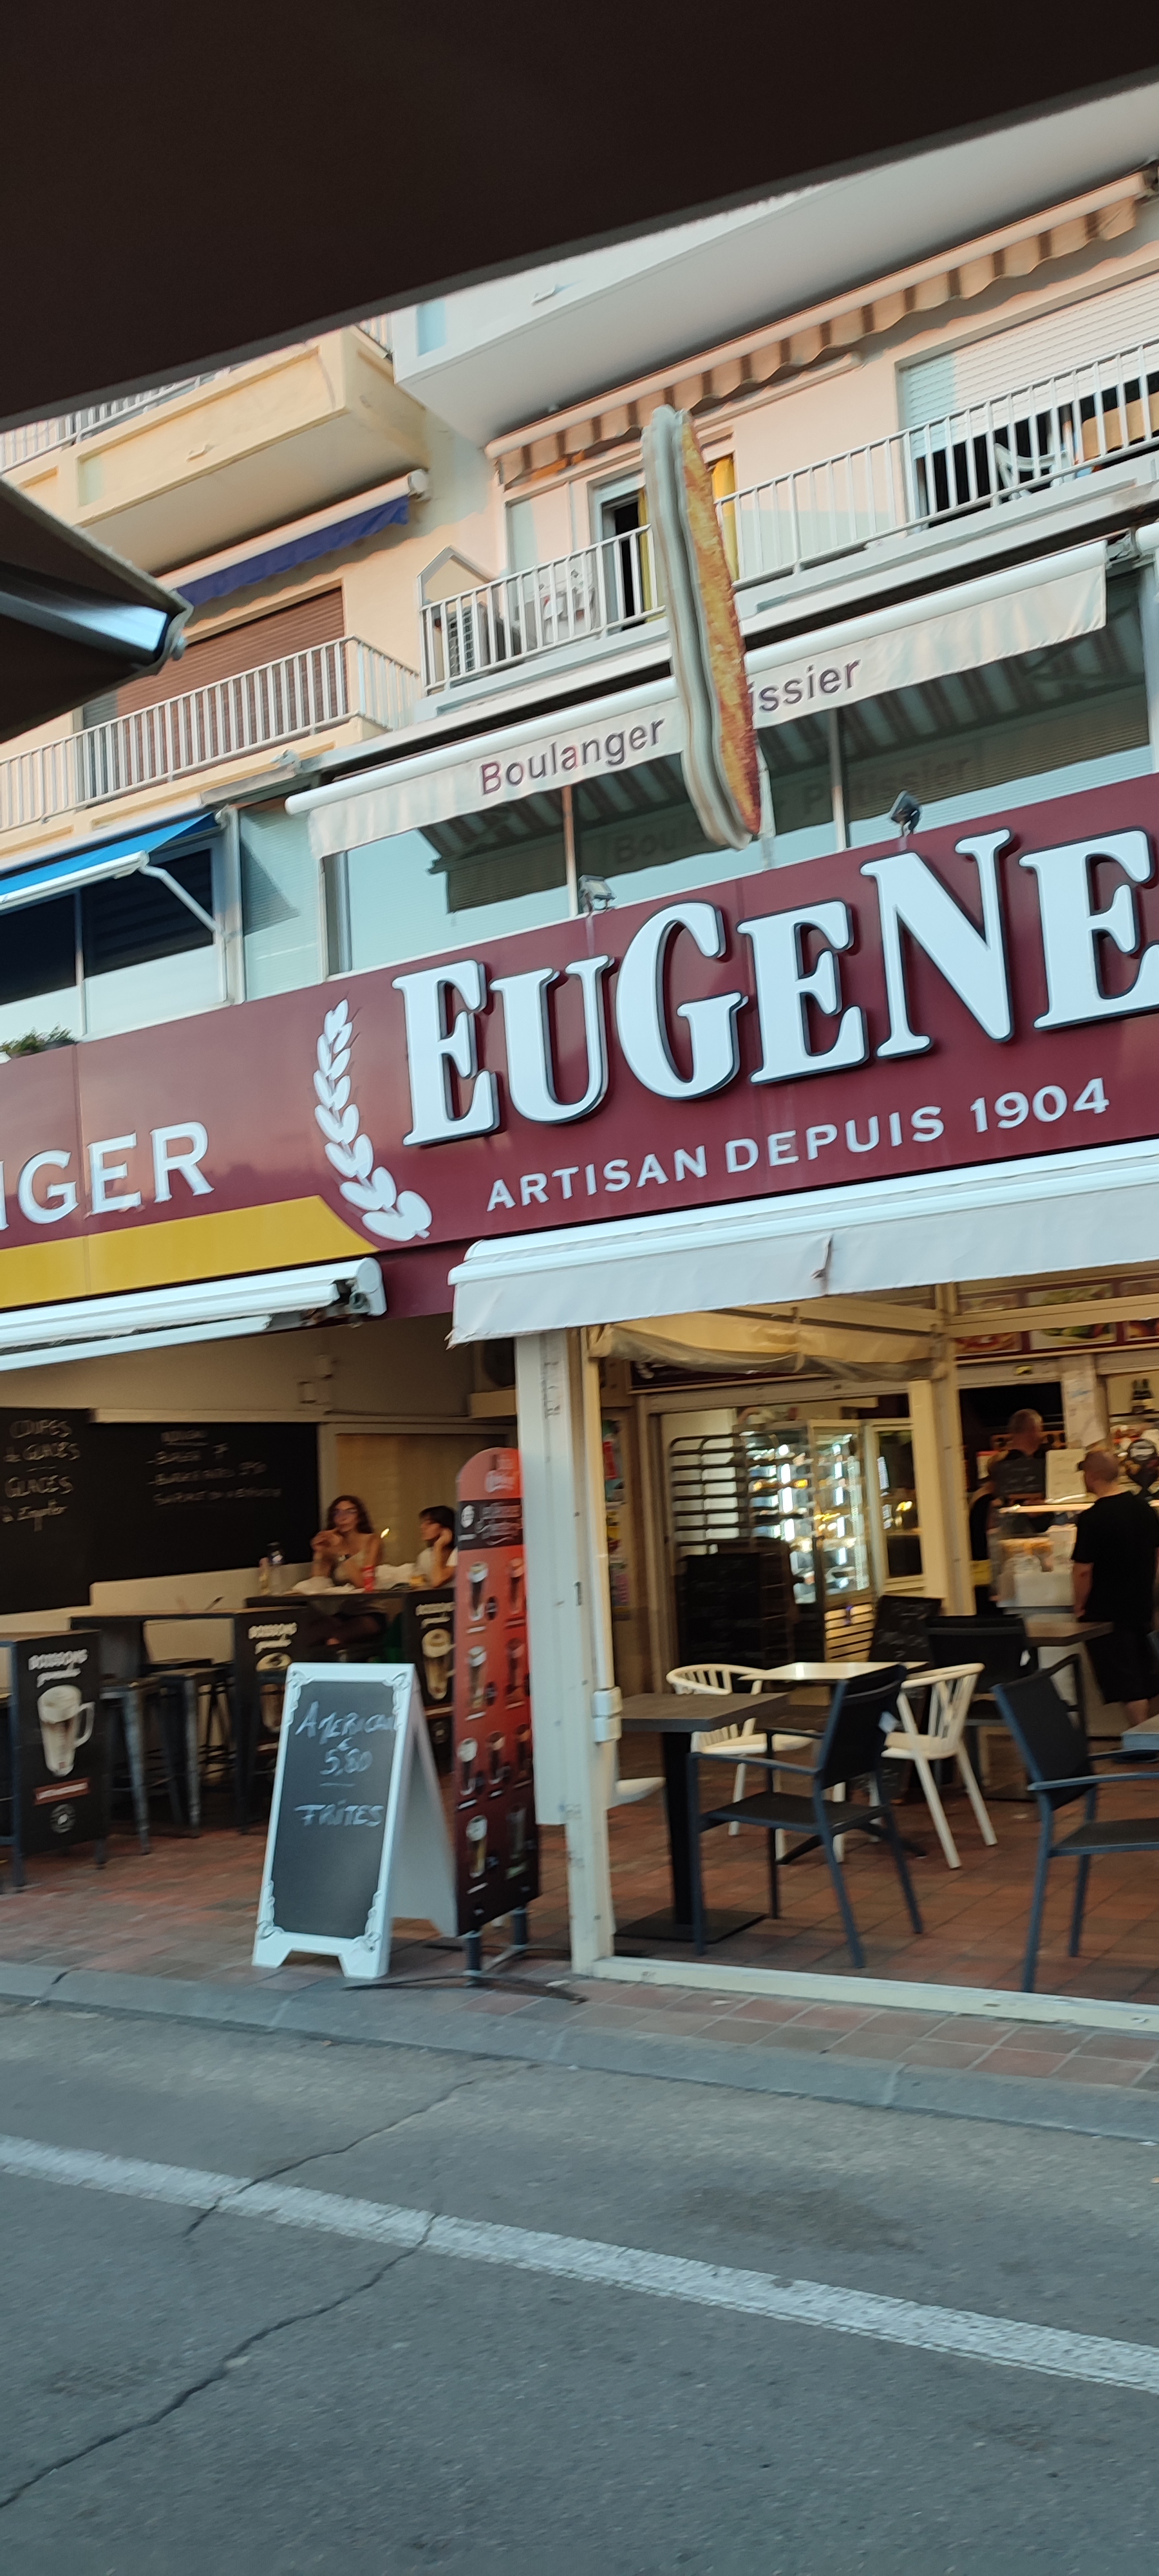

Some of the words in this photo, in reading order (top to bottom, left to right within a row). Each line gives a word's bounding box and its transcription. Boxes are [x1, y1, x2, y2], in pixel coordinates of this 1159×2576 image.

[480, 717, 666, 796] Boulanger
[749, 659, 862, 714] issier
[0, 1121, 215, 1231] GER
[486, 1145, 708, 1213] ARTISAN
[724, 1105, 945, 1173] DEPUIS
[970, 1077, 1110, 1133] 1904
